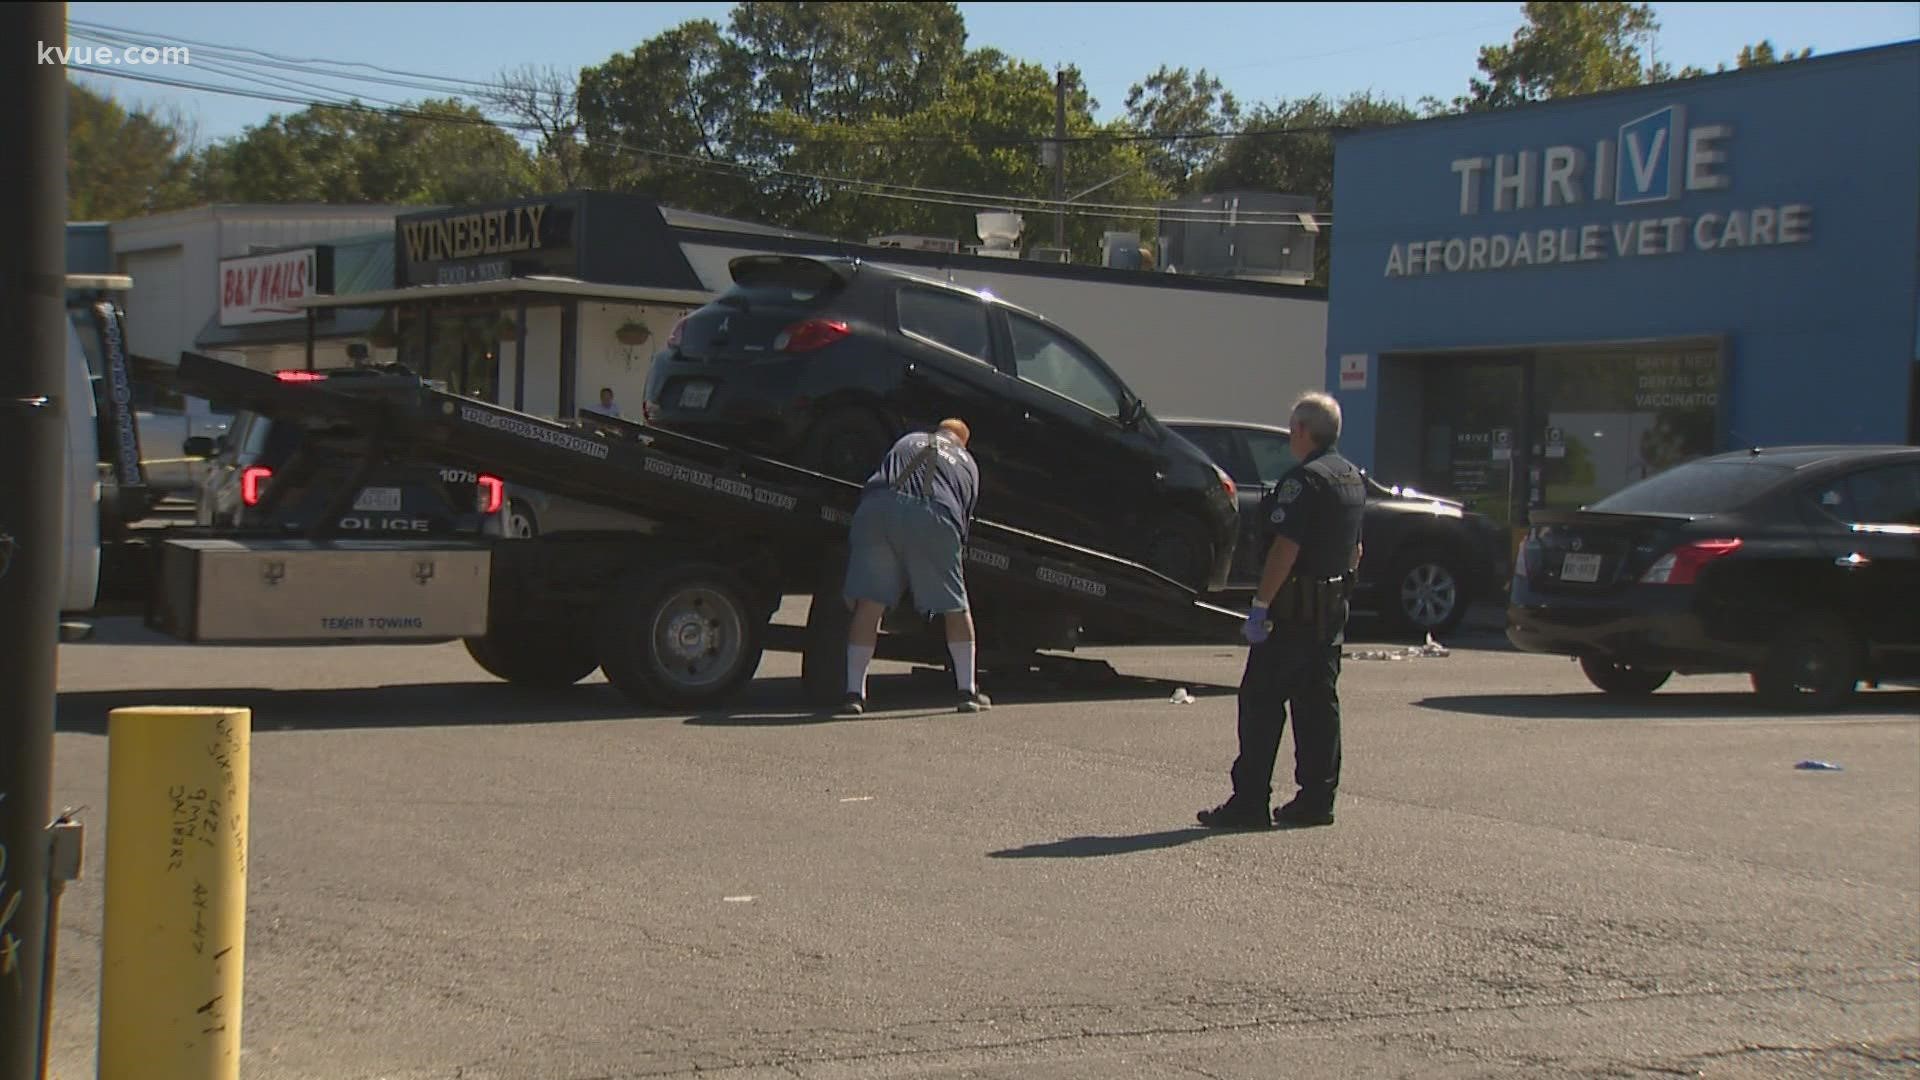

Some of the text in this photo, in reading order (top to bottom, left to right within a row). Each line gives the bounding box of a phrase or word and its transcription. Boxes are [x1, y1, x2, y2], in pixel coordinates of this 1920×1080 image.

[1451, 122, 1733, 215] THRIVE
[402, 203, 546, 263] WINEBELLY
[1385, 203, 1812, 278] AFFORDABLE VET CARE
[259, 258, 305, 305] NAILS
[339, 517, 430, 531] OLICE
[319, 617, 423, 630] TEXAN TOWING
